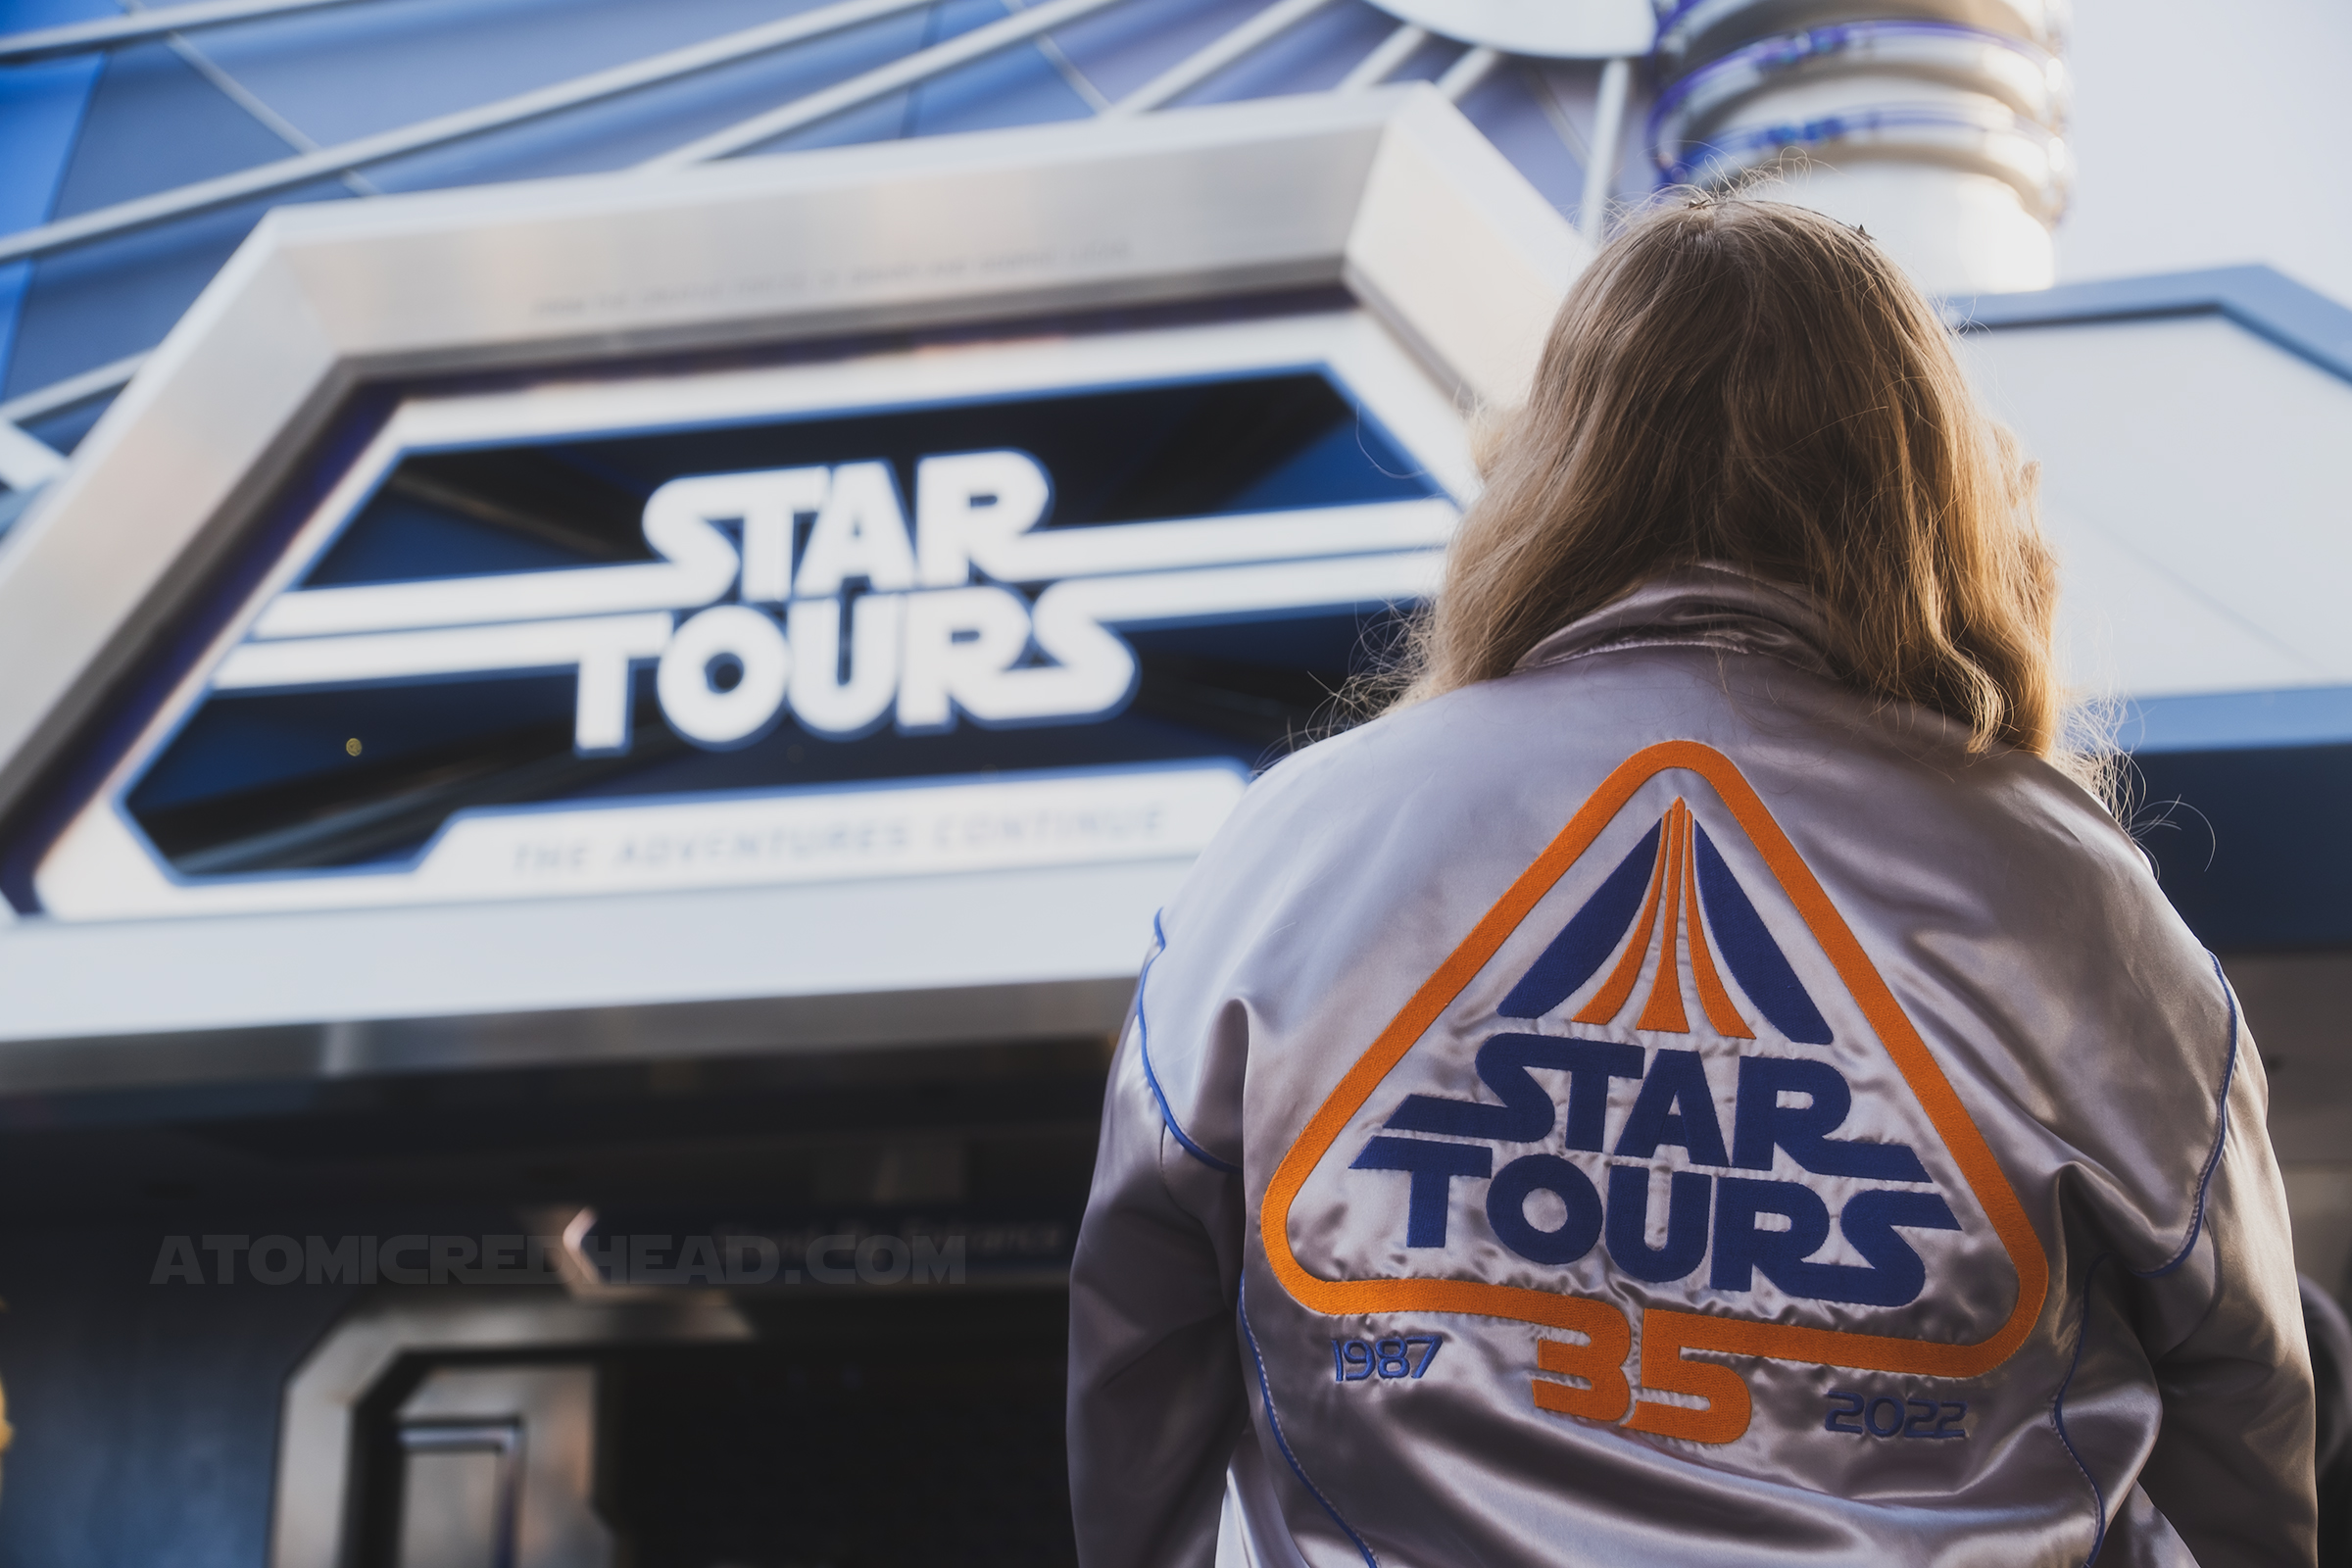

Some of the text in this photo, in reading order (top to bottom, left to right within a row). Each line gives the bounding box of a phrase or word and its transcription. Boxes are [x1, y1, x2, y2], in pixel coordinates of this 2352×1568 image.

[572, 586, 1138, 753] TOURS
[514, 803, 1166, 875] THE ADVENTURES CONTINUE
[1382, 1032, 1934, 1184] STAR
[1348, 1135, 1962, 1307] TOURS
[1331, 1335, 1444, 1383] 1987
[1531, 1296, 1752, 1446] 35
[1825, 1389, 1969, 1441] 2022
